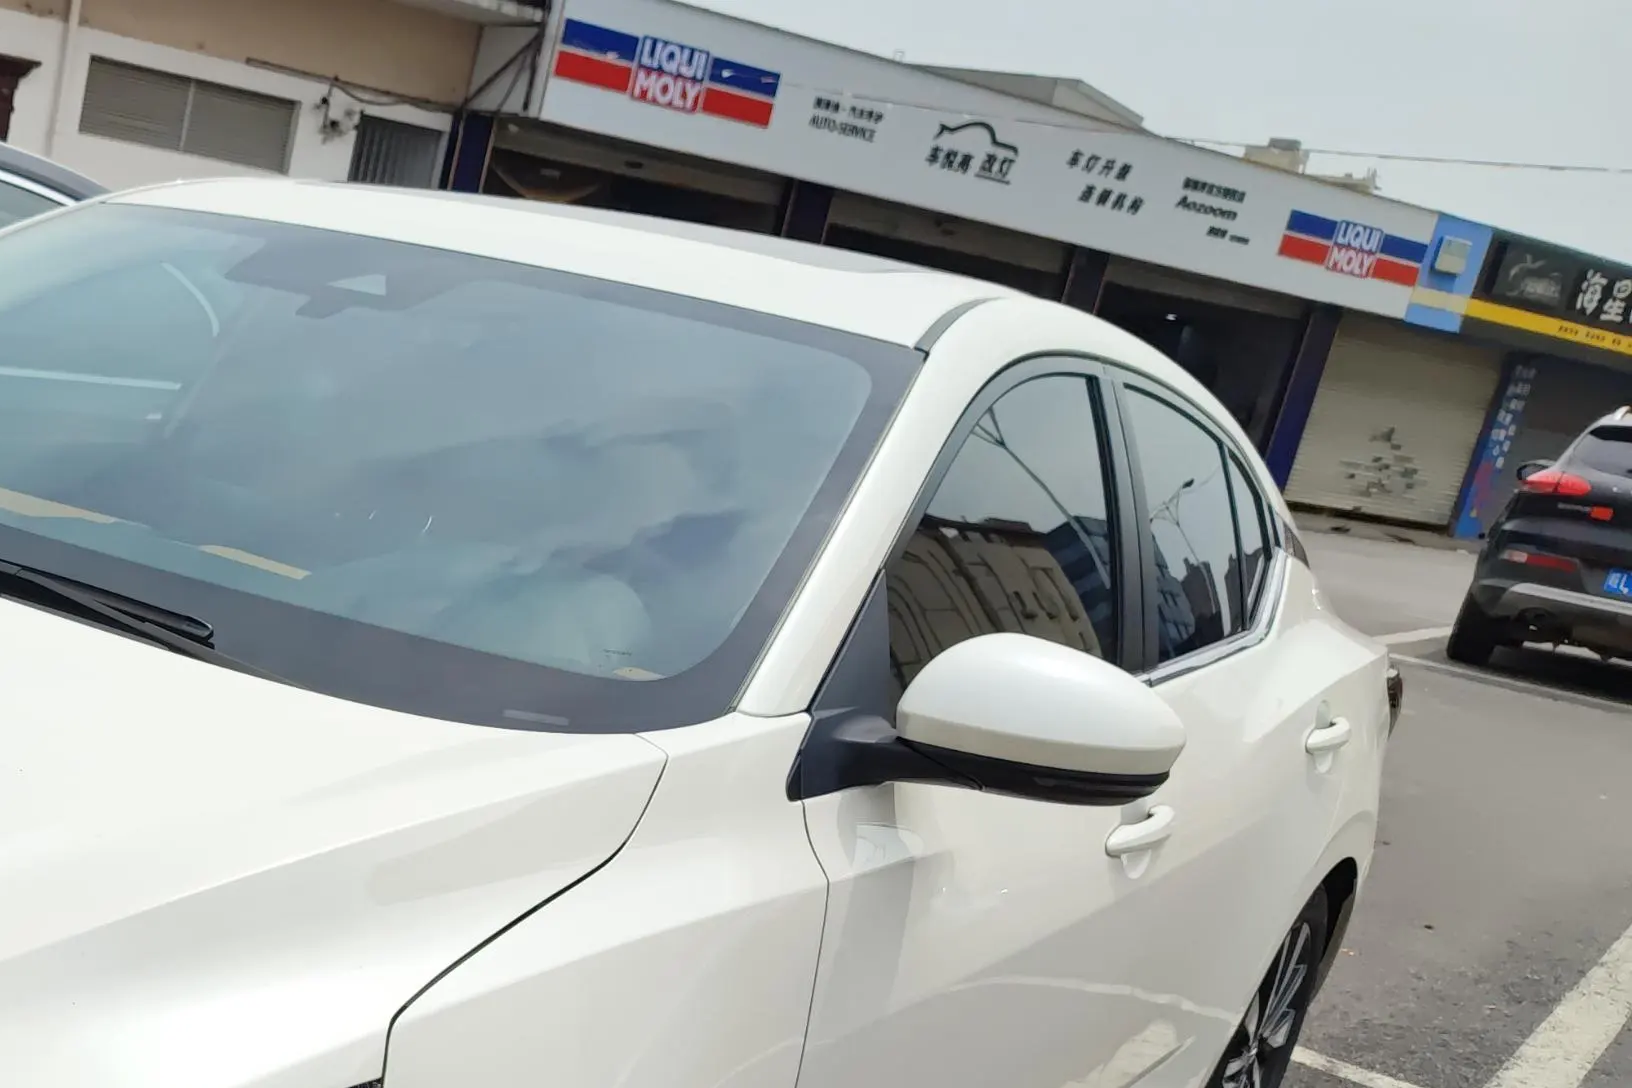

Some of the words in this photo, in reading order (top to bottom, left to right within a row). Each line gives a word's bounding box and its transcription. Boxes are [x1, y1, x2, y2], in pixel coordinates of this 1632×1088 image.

[642, 37, 707, 79] LIQUI
[633, 73, 702, 112] MOLY
[1067, 148, 1132, 182] 车灯升级
[1175, 196, 1238, 221] Aozoom
[1337, 222, 1382, 252] LIQUI
[1328, 247, 1374, 277] MOLY
[1576, 269, 1632, 324] 海星
